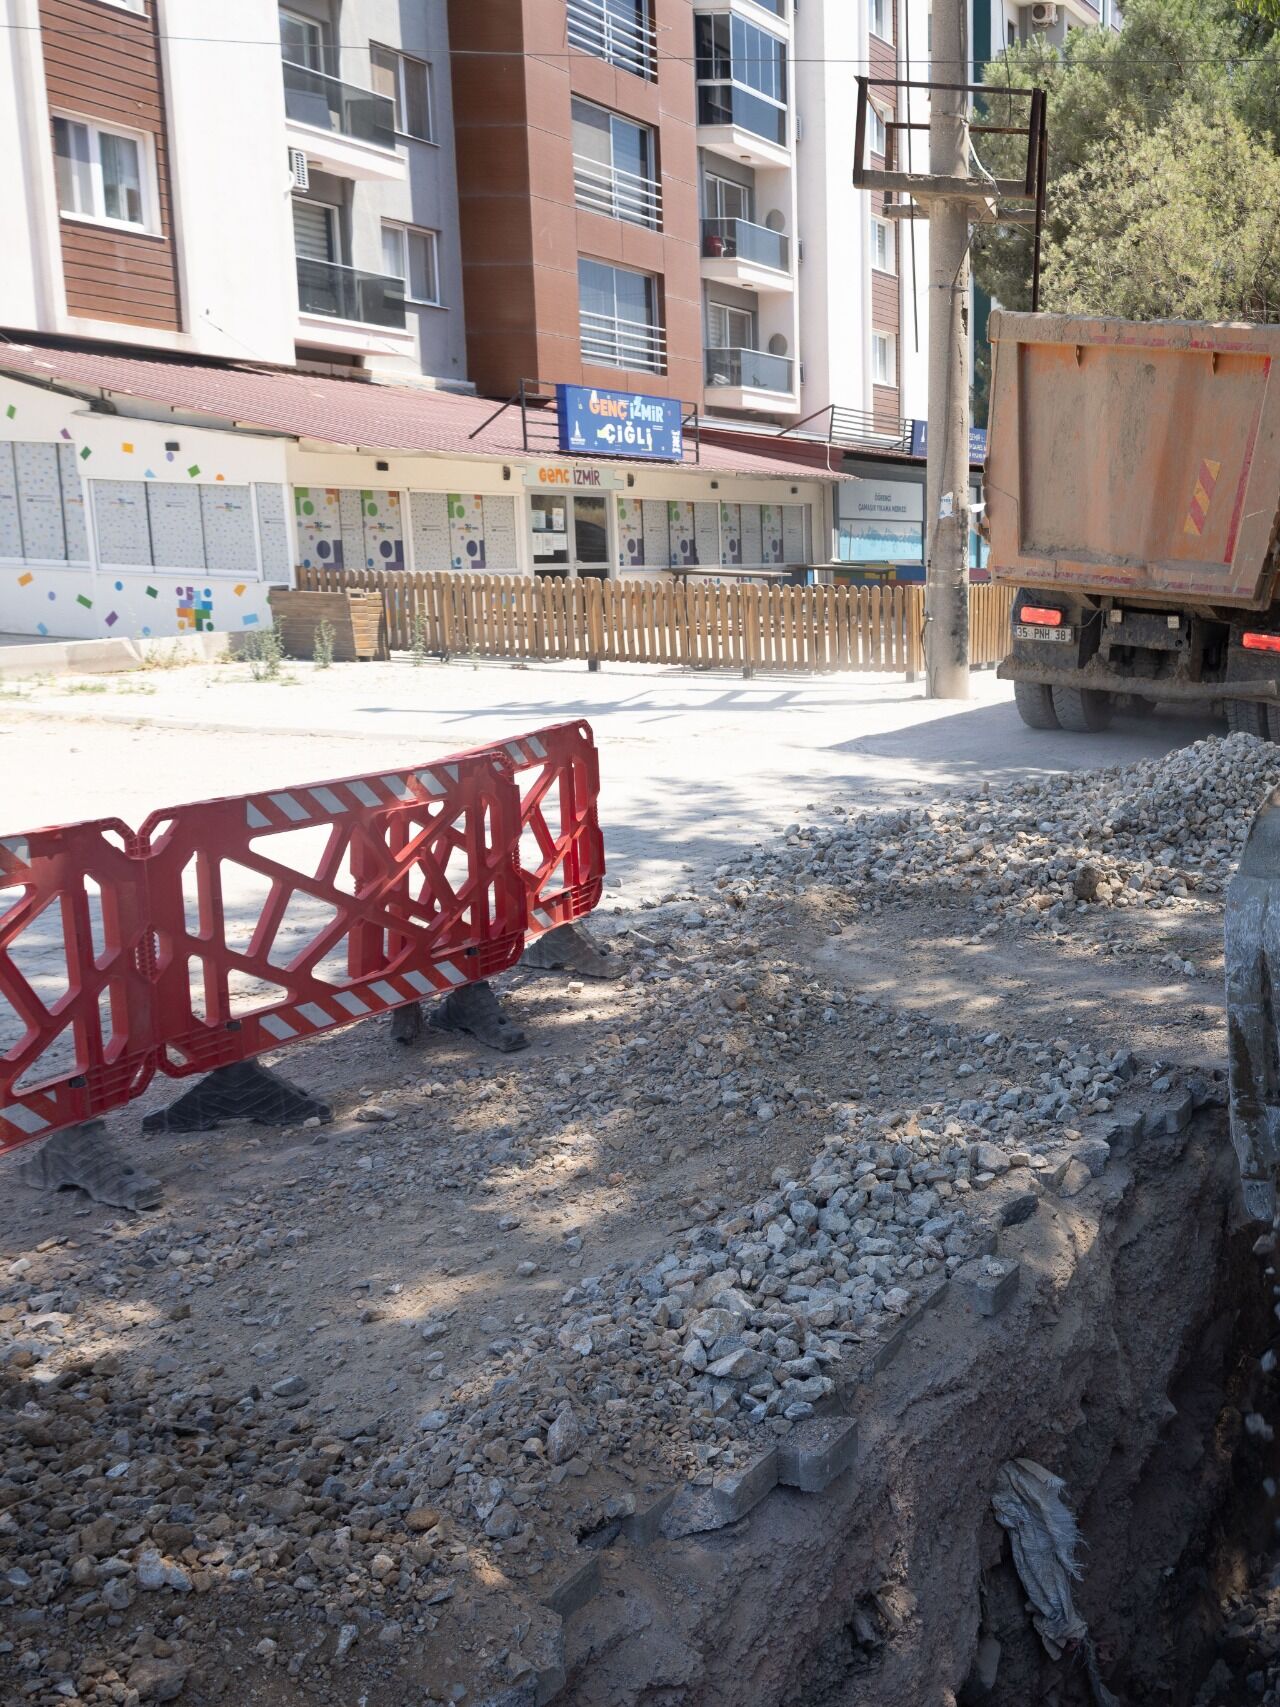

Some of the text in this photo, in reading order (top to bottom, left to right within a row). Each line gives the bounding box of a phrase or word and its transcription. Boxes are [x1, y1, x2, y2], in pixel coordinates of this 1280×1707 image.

[589, 398, 664, 423] GENÇ İZMİR
[604, 421, 653, 445] ÇİĞLİ
[572, 466, 601, 486] İZMİR
[1017, 627, 1028, 638] 35
[1034, 628, 1050, 640] PNH
